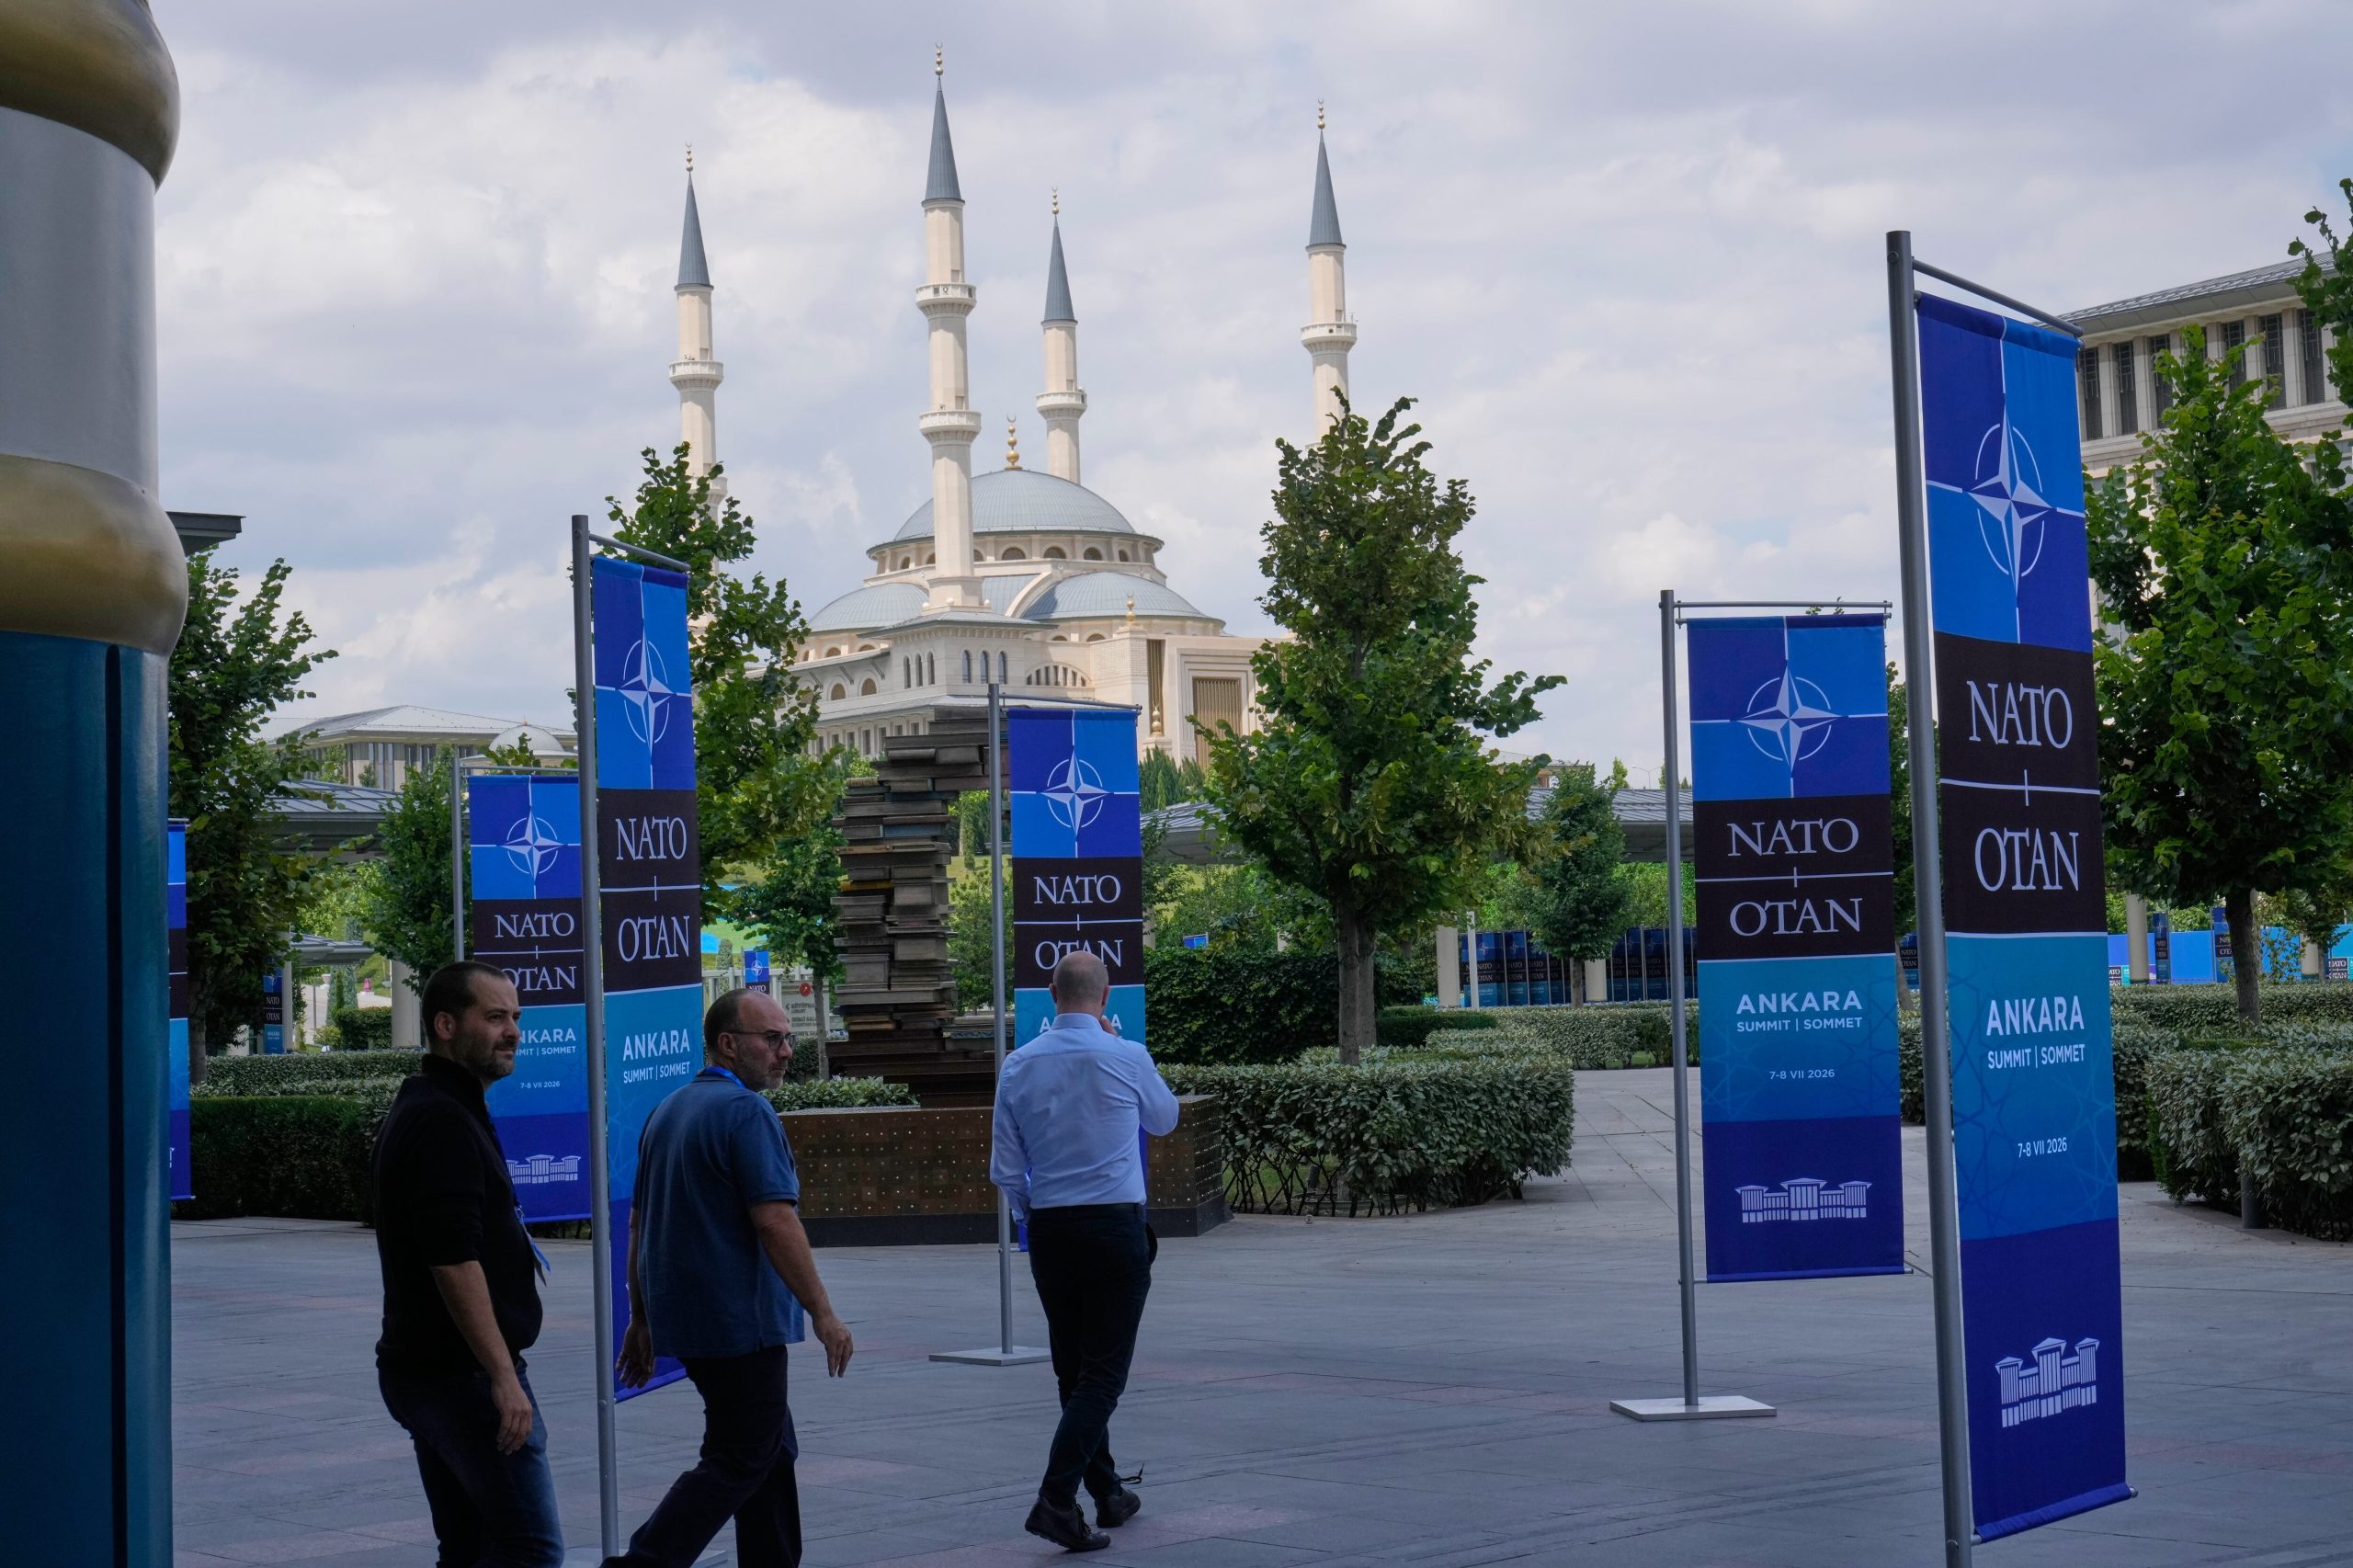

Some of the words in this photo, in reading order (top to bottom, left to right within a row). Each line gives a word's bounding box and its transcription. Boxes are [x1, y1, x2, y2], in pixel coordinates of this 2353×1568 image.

[1966, 680, 2073, 749] NATO
[616, 816, 687, 861] NATO
[1727, 817, 1859, 857] NATO
[1975, 827, 2079, 892] OTAN
[1033, 875, 1121, 904] NATO
[494, 913, 574, 938] NATO
[1730, 898, 1863, 937] OTAN
[619, 915, 689, 962] OTAN
[266, 996, 280, 1005] NATO
[1736, 990, 1863, 1015] ANKARA
[266, 1013, 280, 1021] OTAN
[1736, 1020, 1790, 1032] SUMMIT
[1803, 1017, 1863, 1029] SOMMET
[1986, 995, 2085, 1036] ANKARA
[518, 1028, 576, 1044] NKARA
[623, 1028, 690, 1062] ANKARA
[541, 1046, 576, 1055] SOMMET
[1988, 1049, 2031, 1069] SUMMIT
[2041, 1044, 2085, 1065] SOMMET
[544, 1080, 561, 1088] 2026
[623, 1066, 654, 1084] SUMMIT
[659, 1062, 690, 1078] SOMMET
[1769, 1071, 1787, 1080] 7-8
[1790, 1070, 1804, 1079] VII
[1807, 1069, 1836, 1078] 2026
[2018, 1142, 2031, 1158] 7-8
[2033, 1141, 2045, 1155] VII
[2047, 1137, 2068, 1154] 2026
